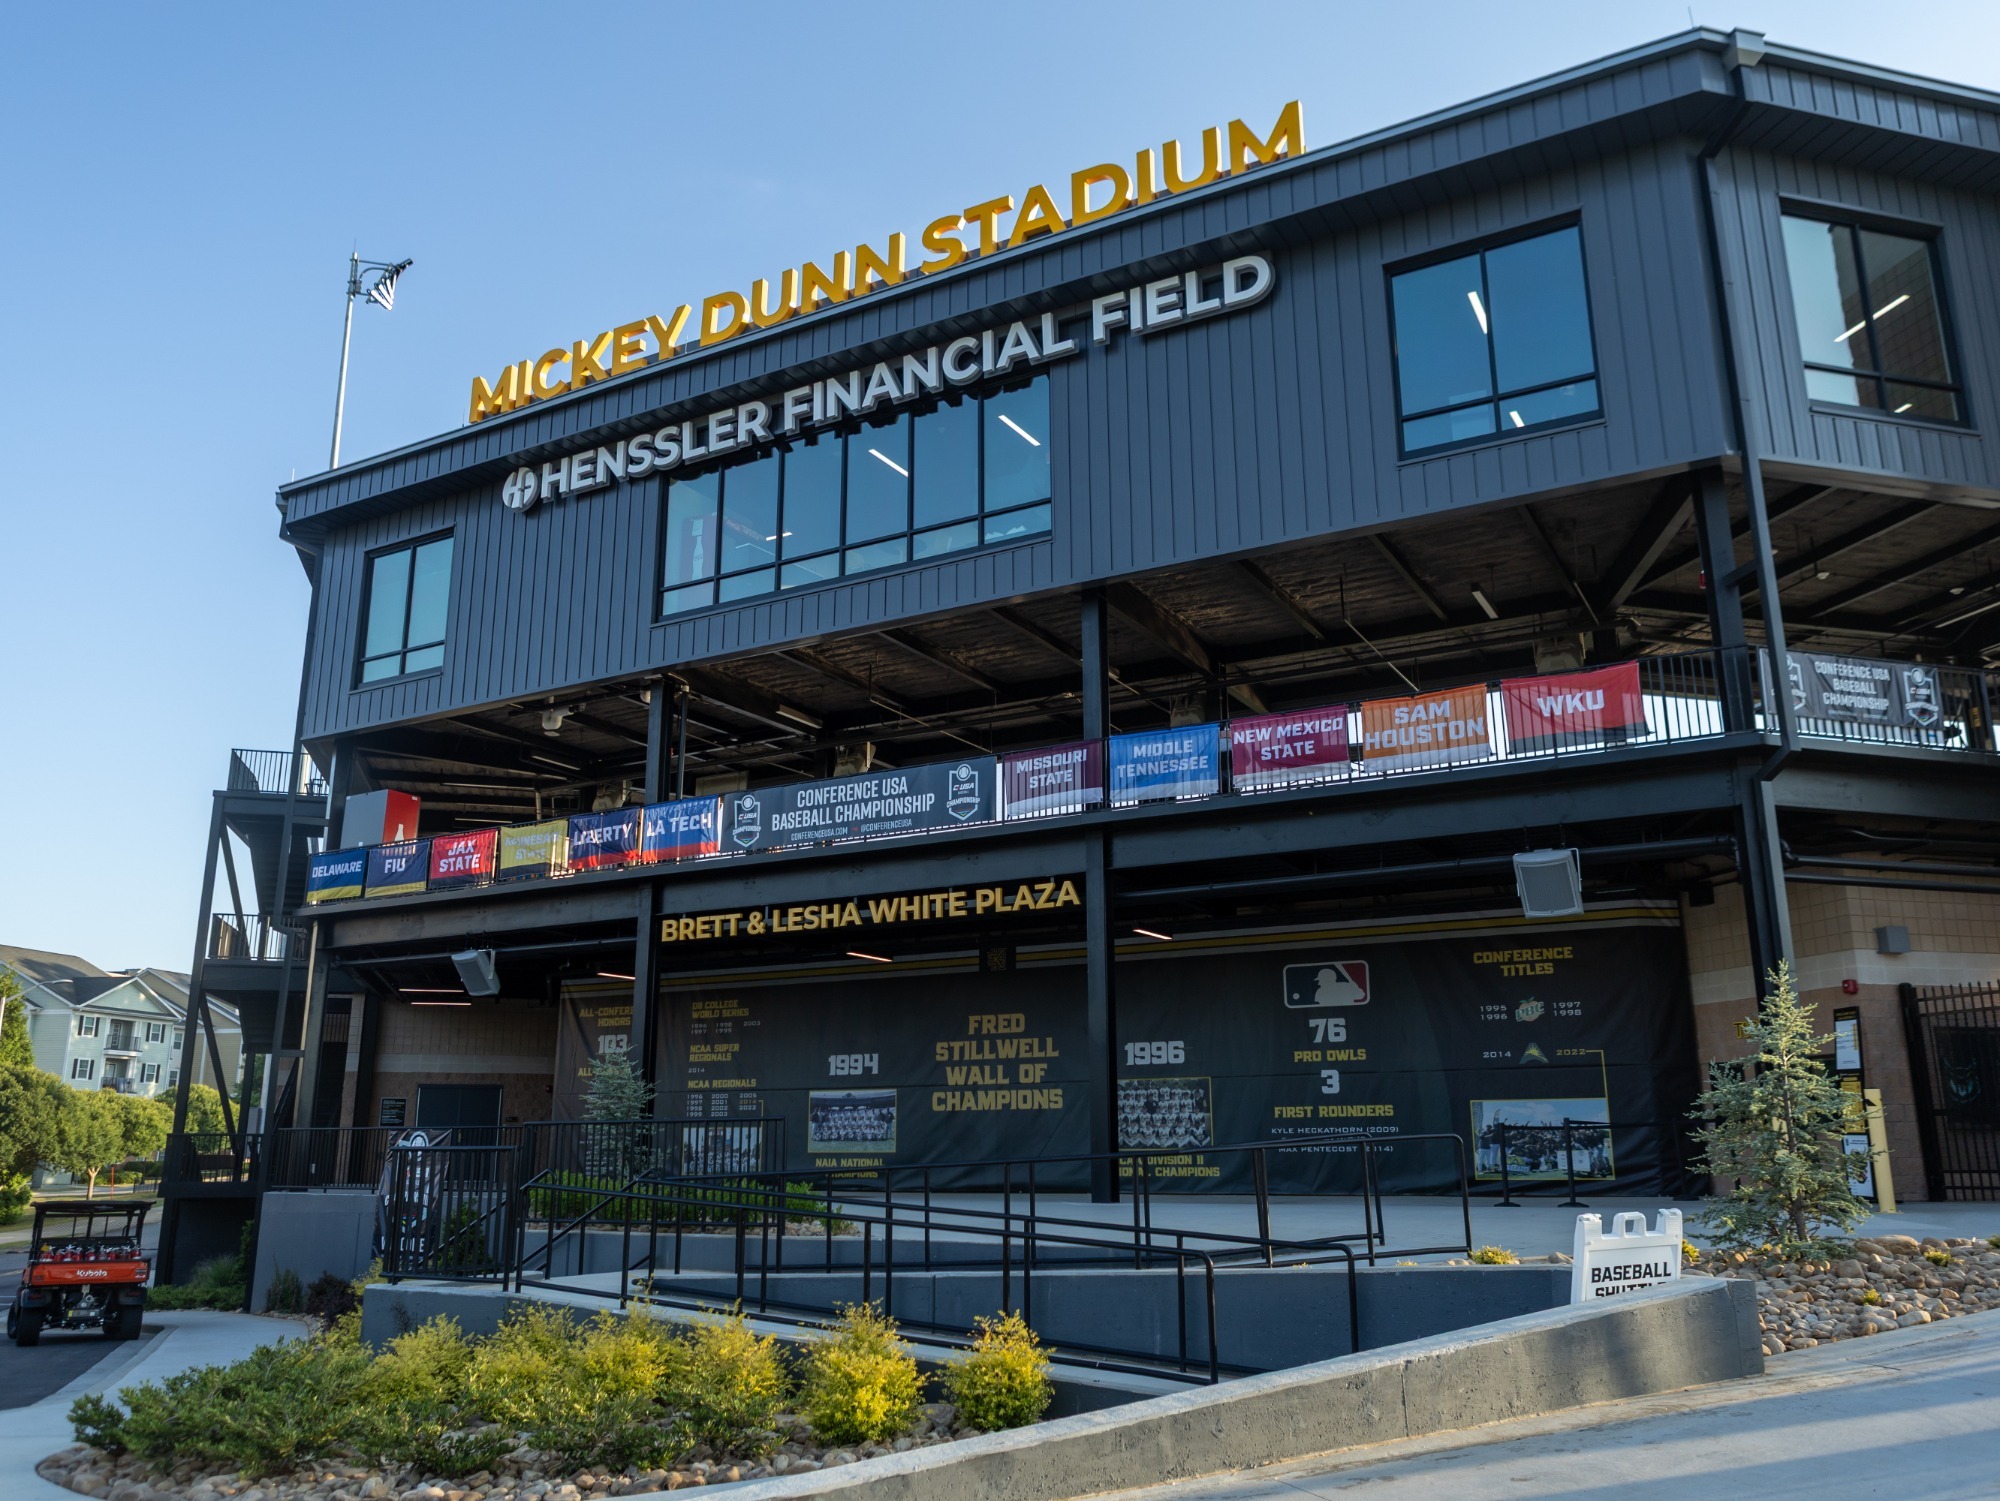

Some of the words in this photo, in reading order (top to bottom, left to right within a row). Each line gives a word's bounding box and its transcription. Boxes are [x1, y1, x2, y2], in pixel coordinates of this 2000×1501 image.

[469, 304, 692, 423] MICKEY
[700, 231, 906, 346] DUNN
[920, 99, 1306, 275] STADIUM
[541, 400, 775, 502] HENSSLER
[784, 312, 1079, 434] FINANCIAL
[1092, 252, 1275, 345] FIELD
[1814, 660, 1872, 678] CONFERENCE
[1872, 668, 1890, 682] USA
[1832, 678, 1877, 695] BASEBALL
[1393, 700, 1451, 724] SAM
[1536, 688, 1606, 717] WKU
[1822, 692, 1890, 711] CHAMPIONSHIP
[1233, 728, 1273, 745] NEW
[1277, 717, 1344, 738] MEXICO
[1364, 716, 1484, 752] HOUSTON
[1133, 739, 1193, 758] MIDDLE
[1260, 740, 1316, 761] STATE
[1016, 749, 1087, 774] MISSOURI
[1117, 756, 1208, 778] TENNESSEE
[1029, 769, 1073, 789] STATE
[797, 780, 879, 808] CONFERENCE
[882, 776, 908, 796] USA
[771, 803, 832, 832] BASEBALL
[835, 793, 935, 823] CHAMPIONSHIP
[573, 822, 633, 846] LIBERTY
[646, 821, 666, 837] LA
[670, 812, 712, 832] TECH
[791, 826, 848, 842] CONFERENCEUSA.COM
[860, 818, 912, 833] @CONFERENCEUSA
[447, 839, 476, 856] JAX
[311, 860, 362, 878] DELAWARE
[383, 858, 406, 874] FIU
[439, 853, 480, 872] STATE
[661, 912, 742, 942] BRETT
[747, 911, 766, 935] &
[772, 902, 862, 933] LESHA
[868, 890, 968, 923] WHITE
[976, 880, 1081, 914] PLAZA
[1473, 947, 1573, 964] CONFERENCE
[1500, 963, 1554, 977] TITLES
[692, 1009, 720, 1019] WORLD
[721, 1008, 750, 1018] SERIES
[705, 999, 739, 1009] COLLEGE
[1480, 1004, 1507, 1012] 1995
[1552, 1001, 1581, 1009] 1997
[597, 1017, 632, 1027] HONORS
[968, 1013, 1025, 1034] FRED
[1480, 1013, 1508, 1021] 1996
[1553, 1009, 1582, 1017] 1998
[1308, 1017, 1347, 1043] 76
[597, 1034, 628, 1054] 103
[690, 1044, 711, 1053] NCAA
[714, 1043, 740, 1053] SUPER
[935, 1037, 1059, 1061] STILLWELL
[1124, 1041, 1185, 1065] 1996
[689, 1052, 732, 1062] REGIONALS
[828, 1053, 879, 1076] 1994
[1294, 1050, 1322, 1062] PRO
[1326, 1049, 1366, 1061] OWLS
[688, 1079, 710, 1089] NCAA
[712, 1078, 757, 1088] REGIONALS
[946, 1065, 1009, 1086] WALL
[1019, 1063, 1047, 1083] OF
[1320, 1069, 1340, 1094] 3
[932, 1089, 1063, 1111] CHAMPIONS
[1274, 1105, 1313, 1118] FIRST
[1318, 1104, 1394, 1117] ROUNDERS
[815, 1158, 837, 1167] NAIA
[1147, 1155, 1192, 1165] DIVISION
[1154, 1166, 1220, 1177] CHAMPIONS
[1591, 1262, 1672, 1283] BASEBALL
